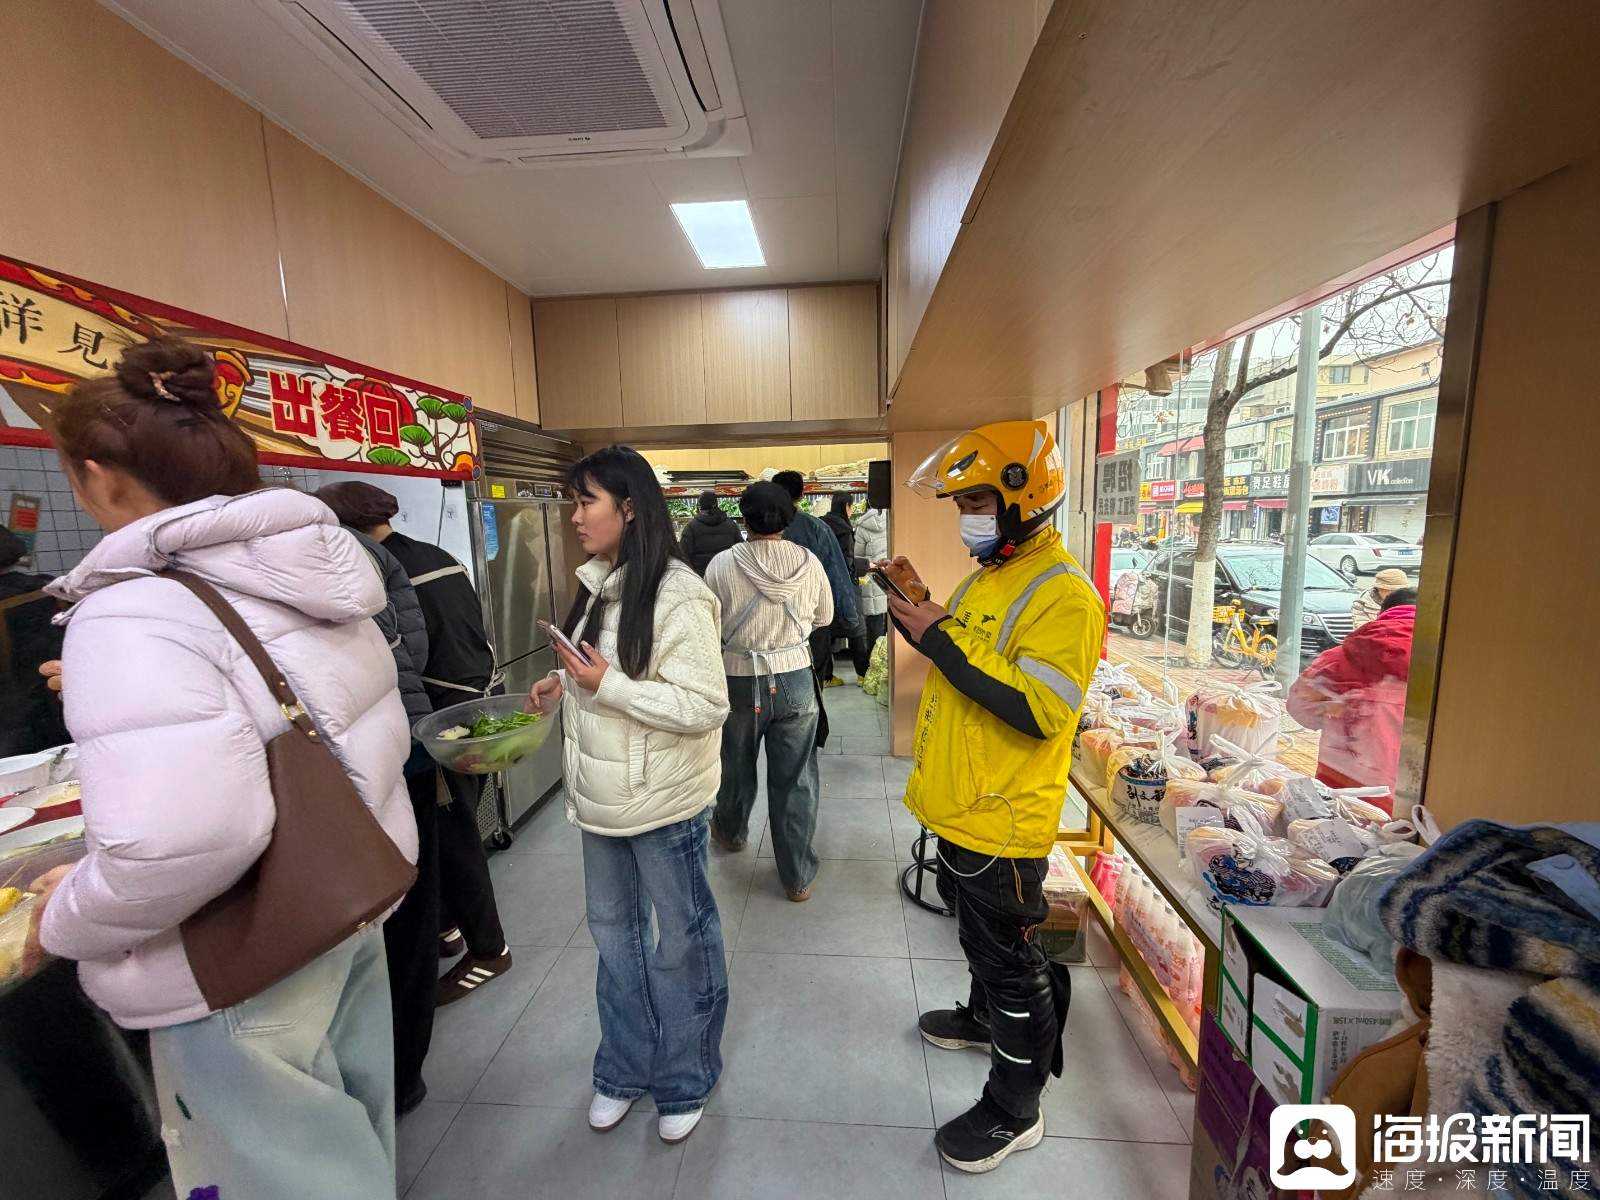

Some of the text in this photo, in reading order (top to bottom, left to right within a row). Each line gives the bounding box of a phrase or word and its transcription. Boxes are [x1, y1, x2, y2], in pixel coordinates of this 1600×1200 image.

[267, 369, 402, 449] 出餐口
[1367, 468, 1392, 485] VK
